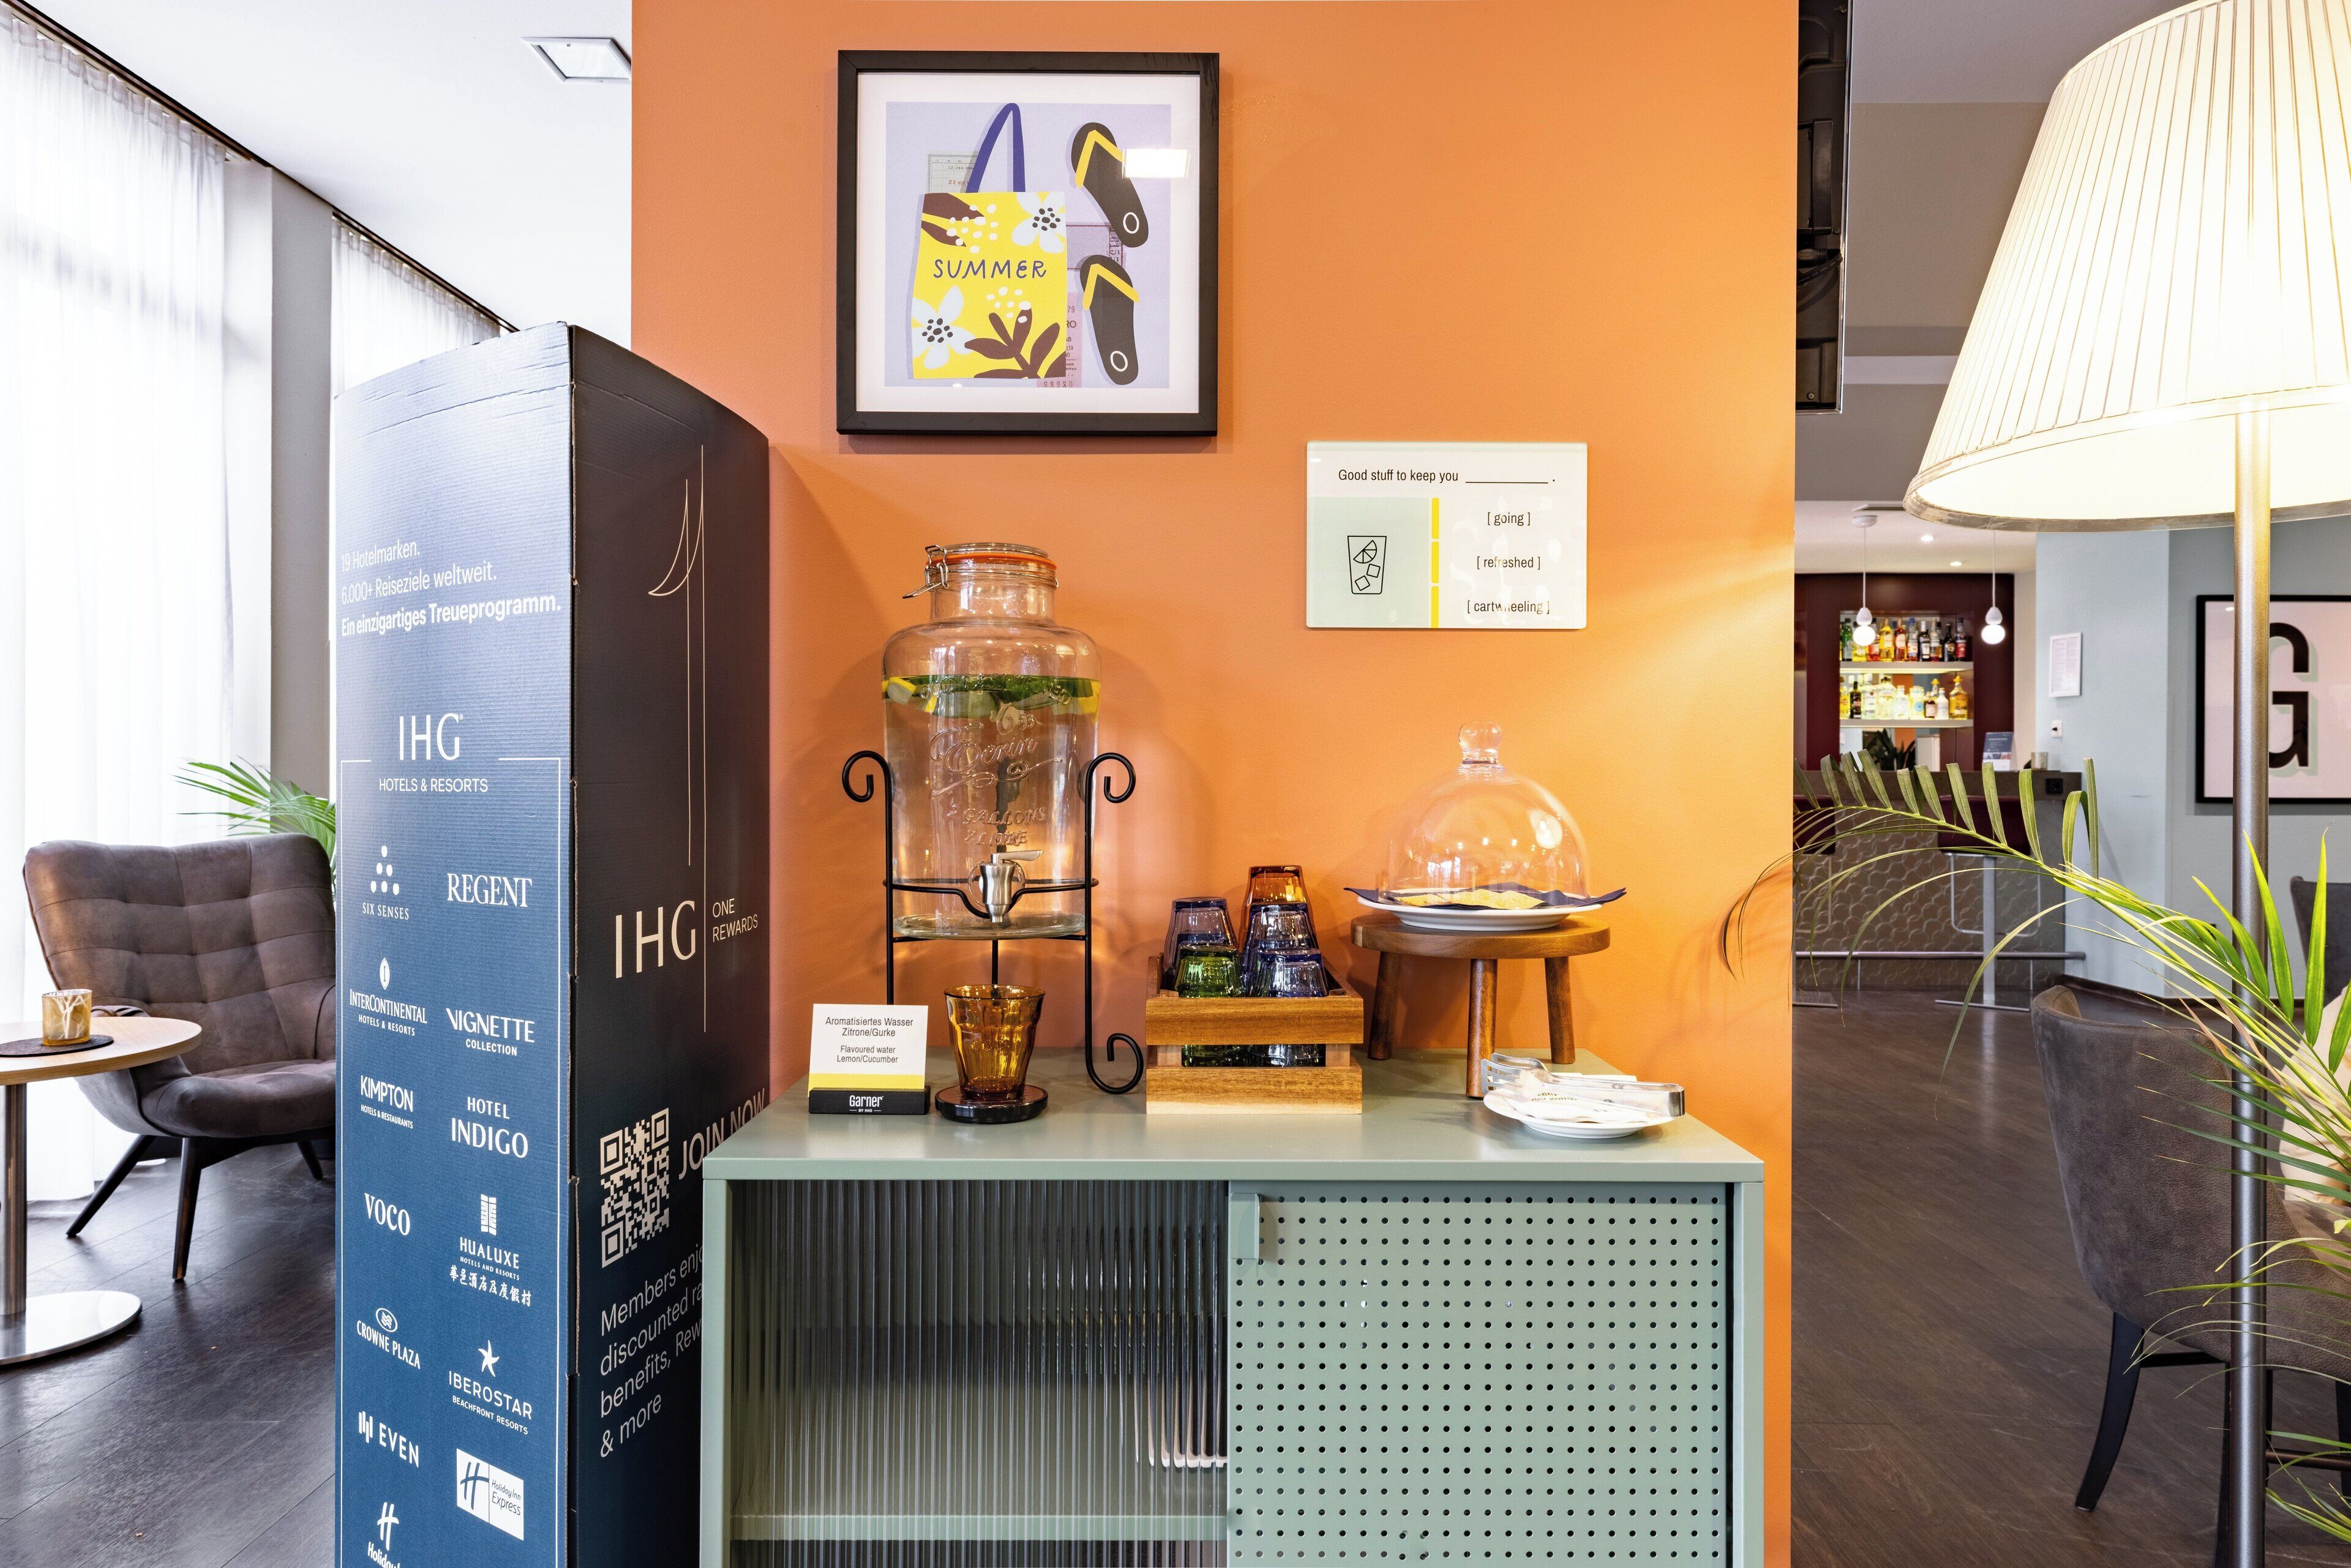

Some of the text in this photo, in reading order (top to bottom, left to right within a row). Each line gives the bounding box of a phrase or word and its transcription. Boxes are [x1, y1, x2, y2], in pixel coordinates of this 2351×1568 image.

[933, 259, 1047, 279] SUMMER
[1338, 469, 1458, 484] Good stuff to keep you
[341, 539, 421, 572] 19 Hotelmarken.
[341, 560, 497, 605] 6.000+ Reiseziele weltweit.
[342, 594, 561, 637] Ein einzigartiges Treueprogramm.
[379, 778, 489, 793] HOTELS & RESORTS
[447, 873, 533, 908] REGENT
[712, 898, 735, 918] ONE
[362, 902, 410, 921] SIX SENSES
[713, 914, 758, 943] REWARDS
[615, 900, 696, 979] IHG
[350, 989, 428, 1024] INTERCONTINENTAL
[825, 1016, 913, 1027] Aromatisiertes Wasser
[358, 1014, 415, 1037] HOTELS & RESORTS
[446, 1008, 535, 1043] VIGNETTE
[842, 1027, 896, 1037] Zitrone/Gurke
[465, 1038, 517, 1056] COLLECTION
[361, 1075, 413, 1112] KIMPTON
[467, 1097, 510, 1120] HOTEL
[849, 1095, 883, 1108] Garner
[361, 1104, 377, 1117] HOTELS
[381, 1111, 413, 1129] RESTAURANTS
[451, 1117, 529, 1158] INDIGO
[678, 1117, 724, 1180] JOIN
[364, 1192, 411, 1236] VOCO
[459, 1236, 520, 1270] HUALUXE
[460, 1256, 520, 1281] HOTELS AND RESORTS
[601, 1268, 676, 1337] Members
[356, 1319, 421, 1370] CROWNE PLAZA
[600, 1286, 688, 1376] discounted
[448, 1370, 533, 1420] IBEROSTAR
[601, 1350, 671, 1419] benefits,
[452, 1395, 528, 1435] BEACHFRONT RESORTS
[600, 1394, 662, 1458] & more
[378, 1422, 419, 1469] EVEN
[492, 1491, 521, 1516] Express
